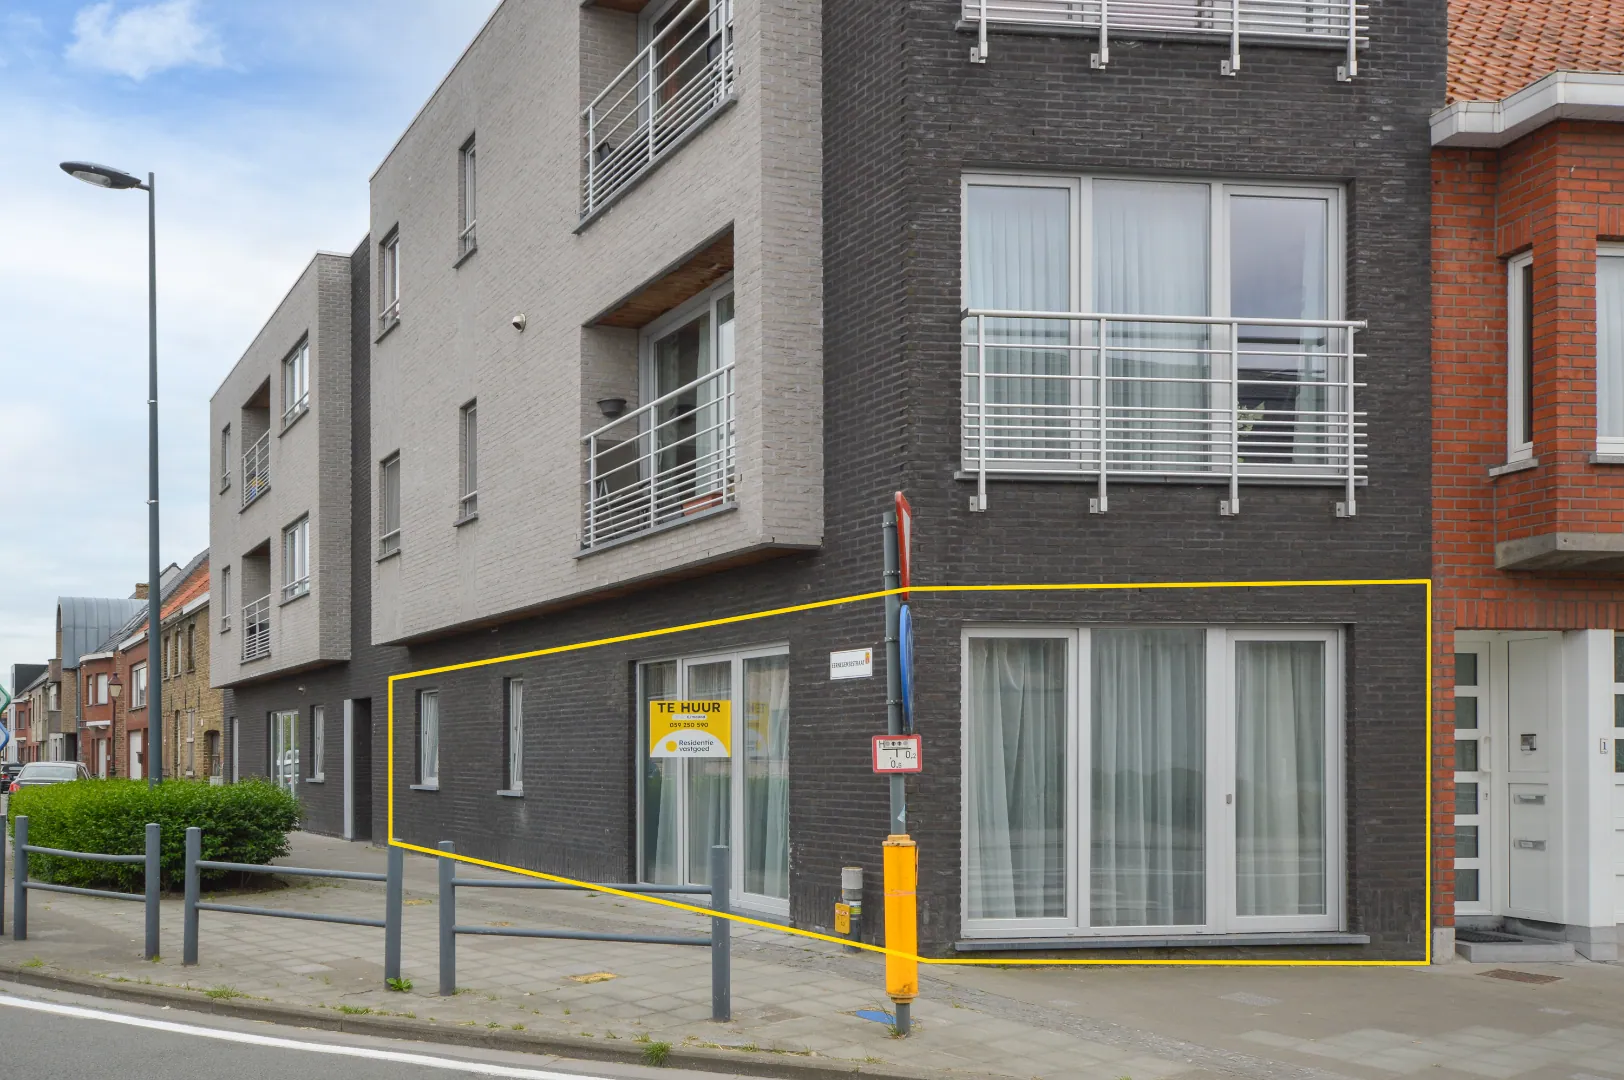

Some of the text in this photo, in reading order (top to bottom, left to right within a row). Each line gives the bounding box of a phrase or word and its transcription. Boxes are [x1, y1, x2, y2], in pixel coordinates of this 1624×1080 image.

[657, 702, 721, 713] TE HUUR
[678, 745, 710, 753] vastgoed
